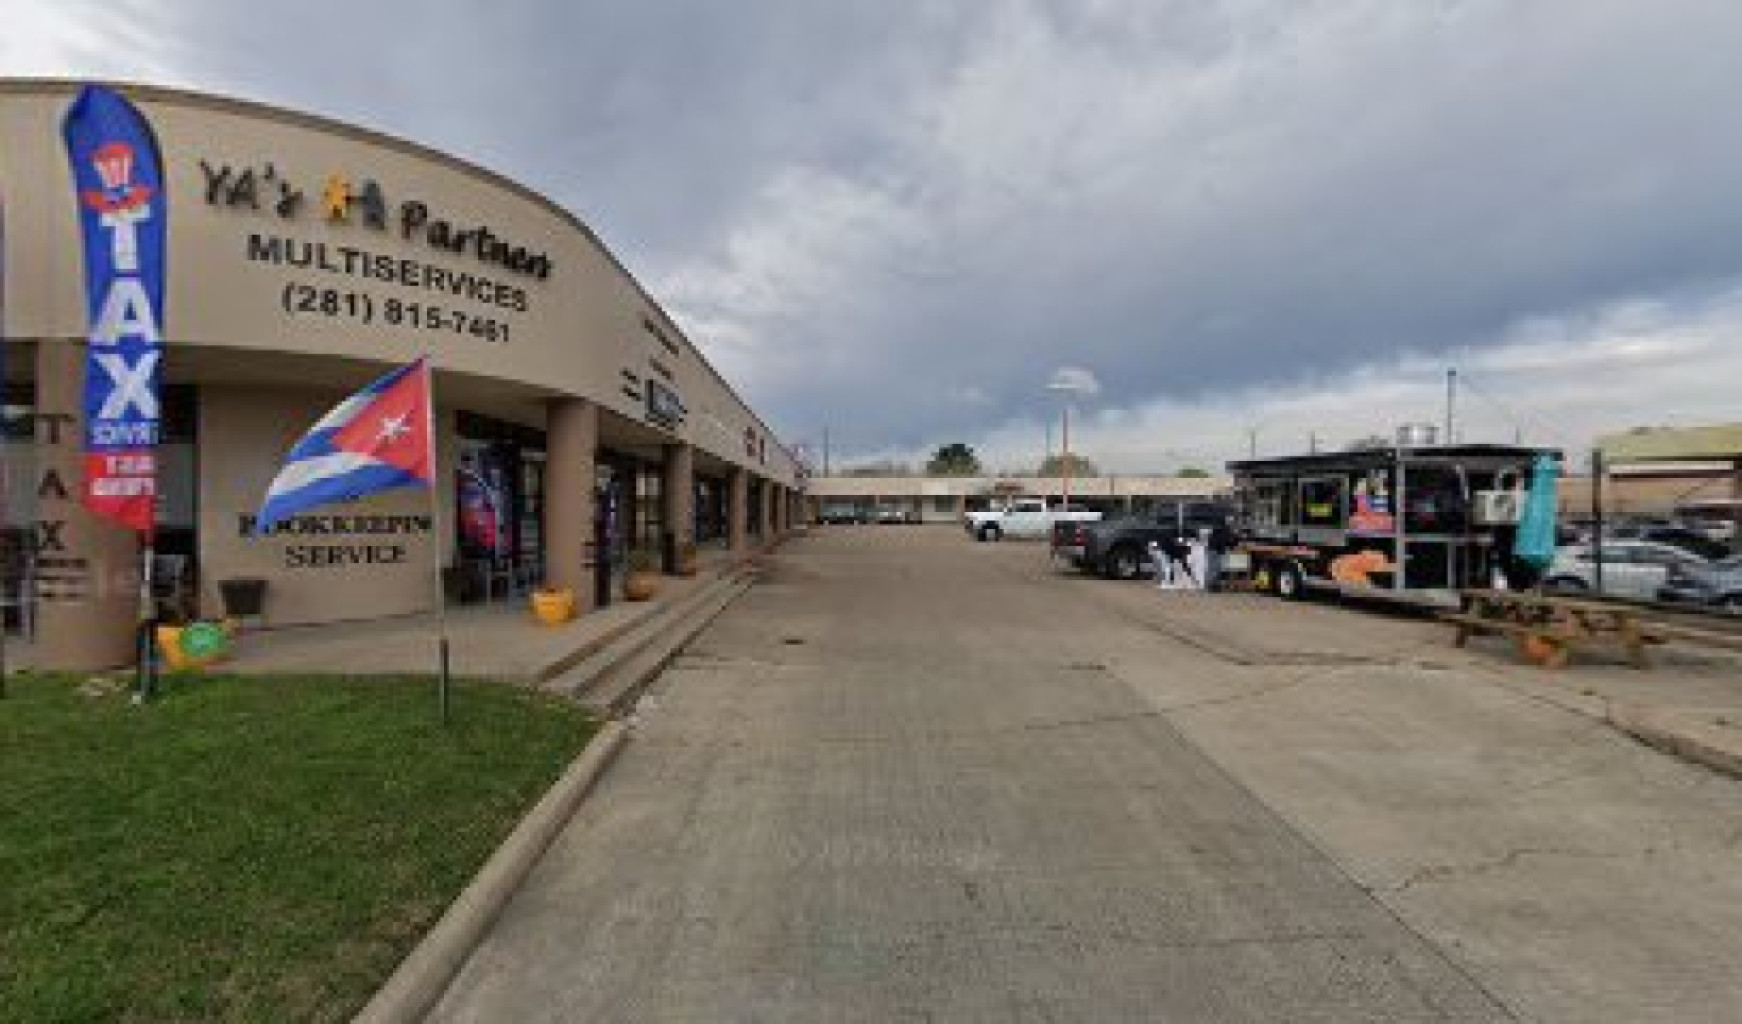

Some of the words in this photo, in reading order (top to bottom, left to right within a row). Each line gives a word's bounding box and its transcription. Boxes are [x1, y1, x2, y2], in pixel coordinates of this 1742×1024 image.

[248, 235, 528, 312] MULTISERVICES
[281, 281, 373, 325] (281)
[90, 204, 163, 420] TAX
[285, 545, 406, 568] SERVICE
